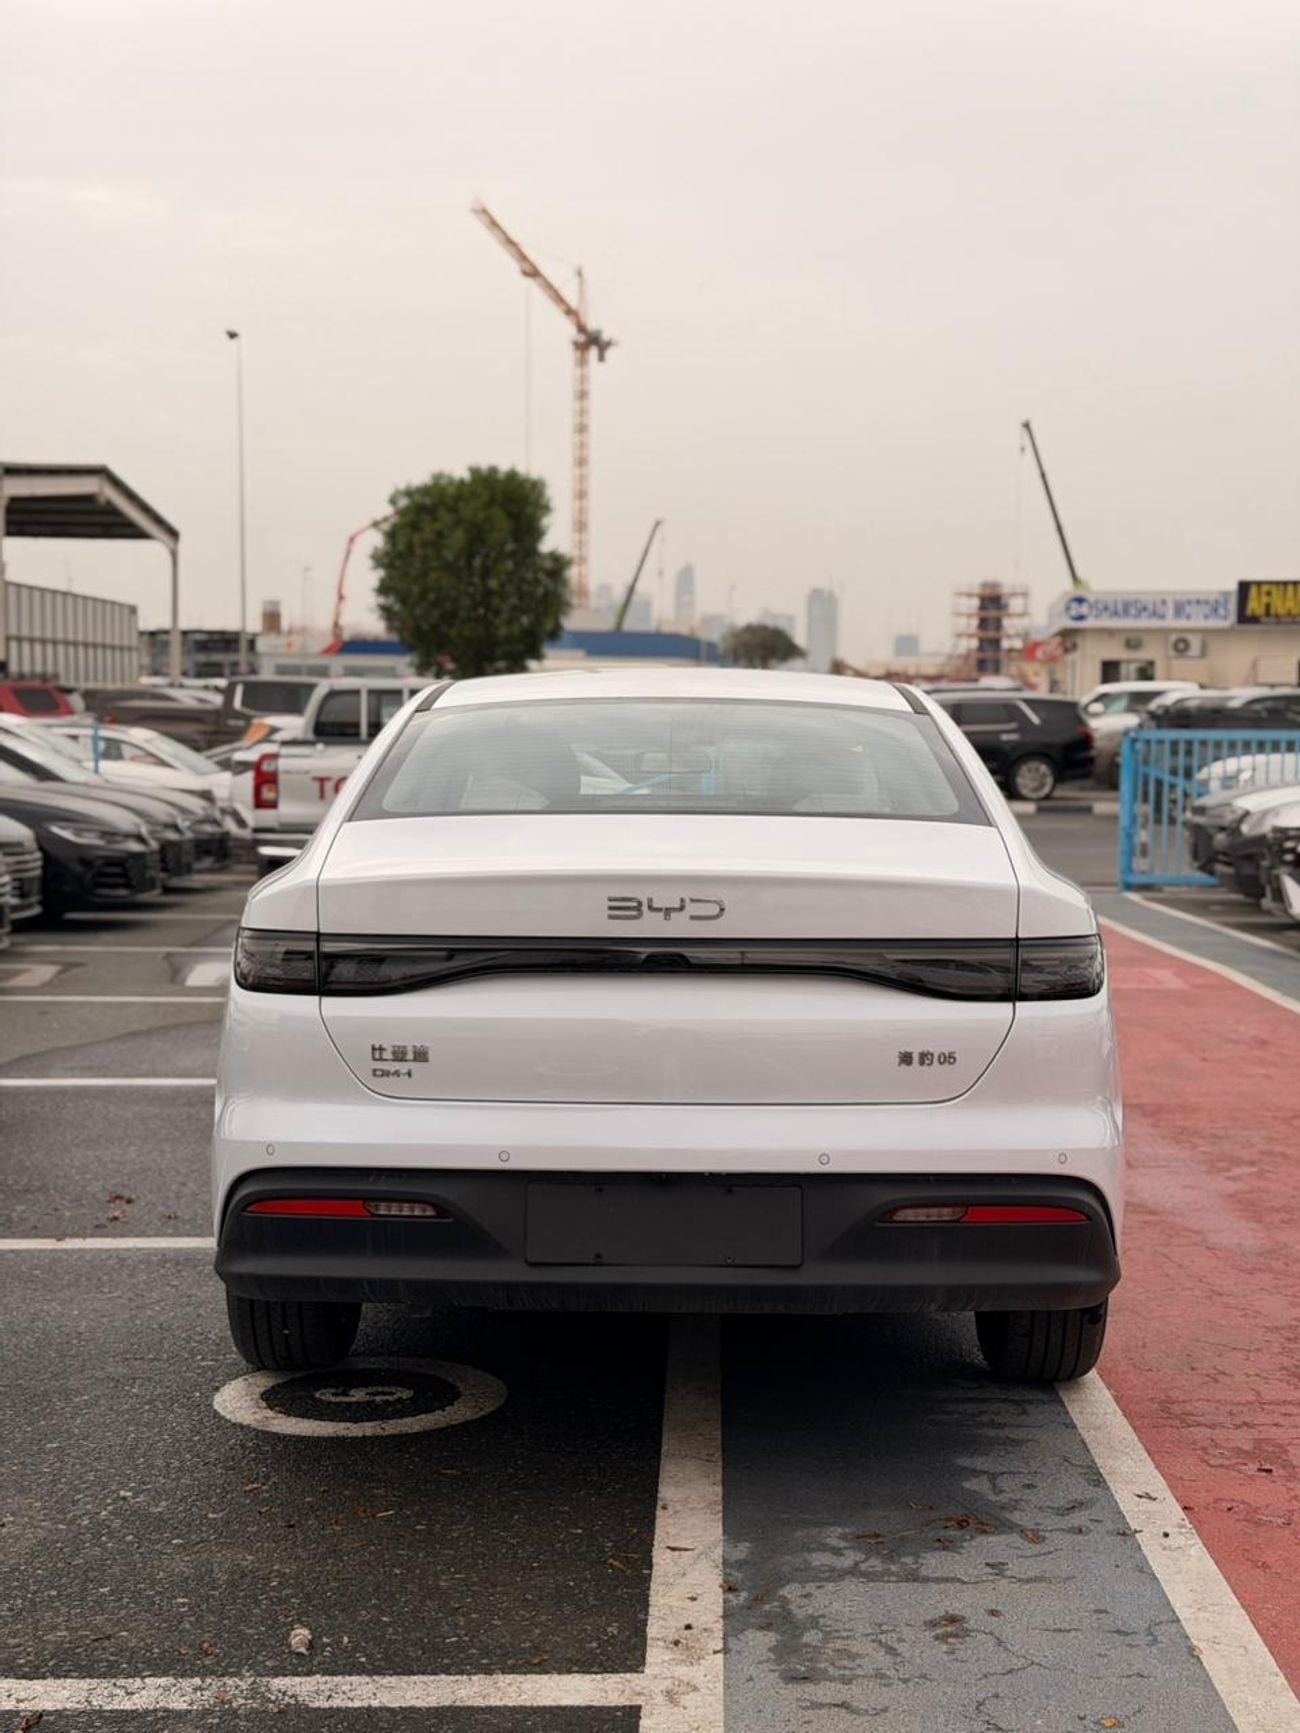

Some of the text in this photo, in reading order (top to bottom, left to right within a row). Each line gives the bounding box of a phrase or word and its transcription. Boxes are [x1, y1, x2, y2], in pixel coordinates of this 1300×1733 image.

[1172, 597, 1229, 620] MOTORS
[1246, 583, 1300, 617] AFNA
[607, 896, 726, 921] BYD
